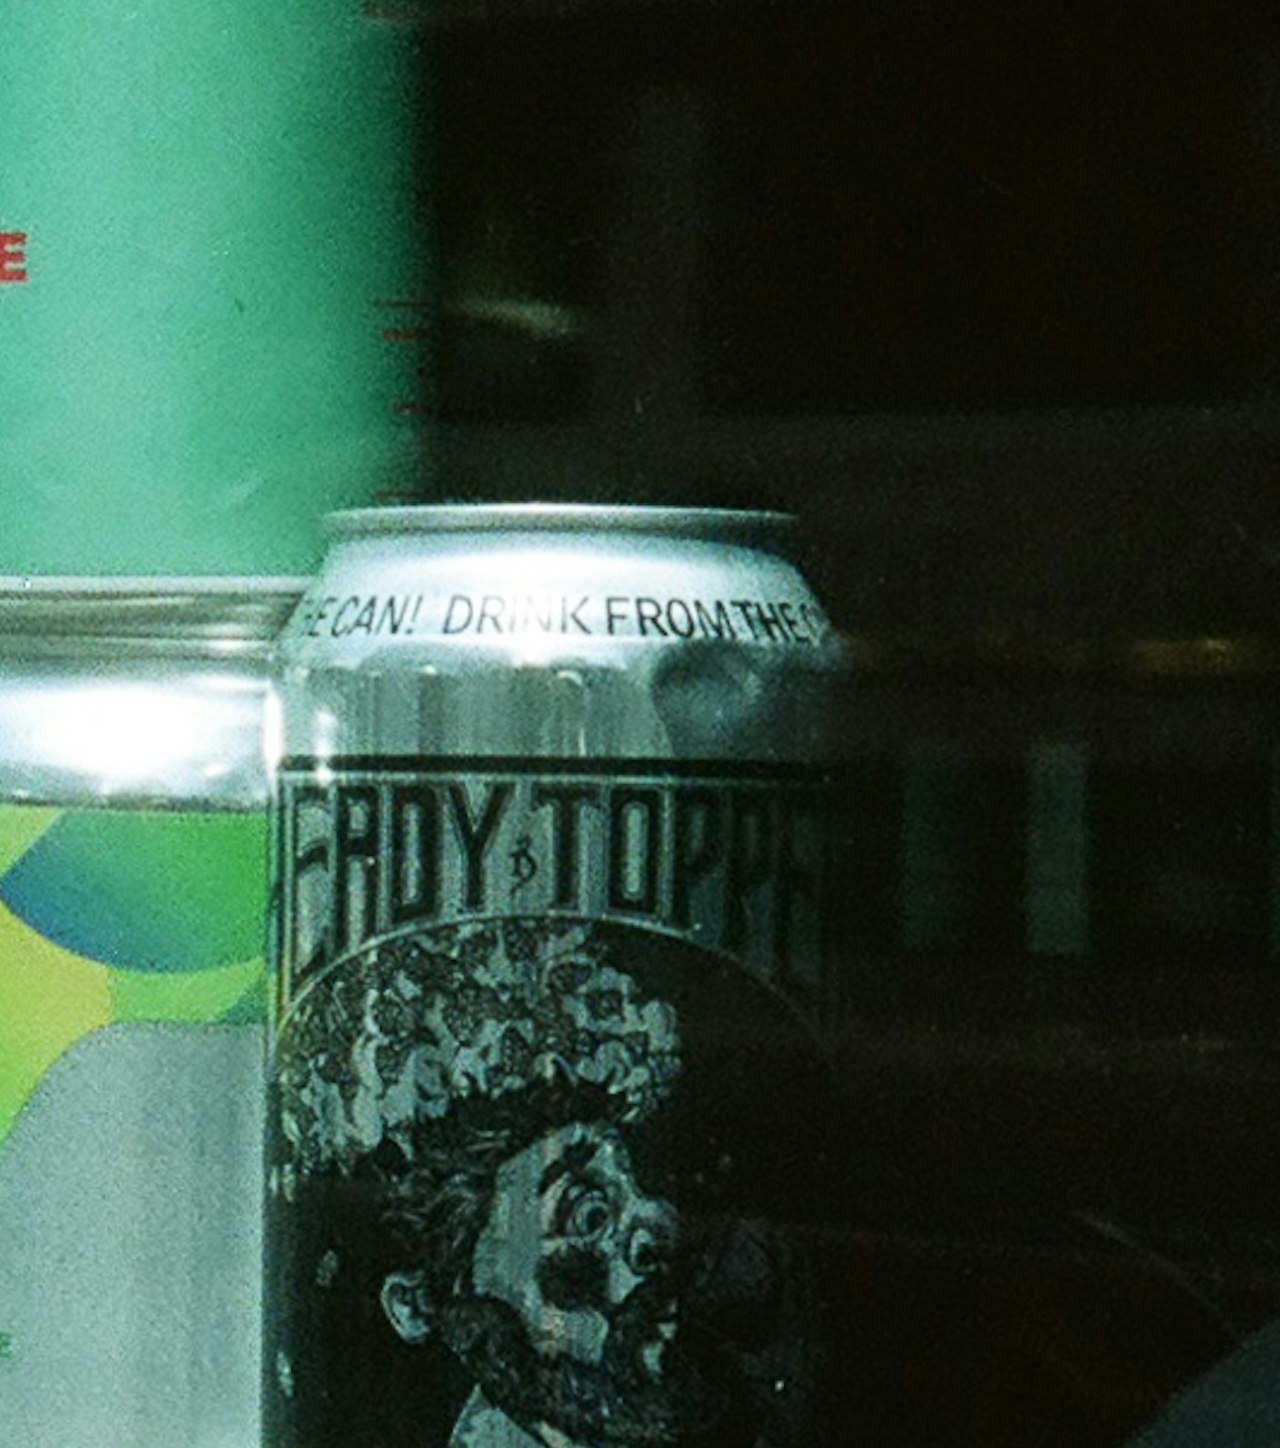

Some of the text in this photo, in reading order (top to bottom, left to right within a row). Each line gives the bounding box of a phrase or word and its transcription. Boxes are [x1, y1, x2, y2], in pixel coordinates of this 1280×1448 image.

[330, 594, 423, 637] CAN!
[441, 593, 589, 636] DRINK
[604, 596, 736, 644] FROM
